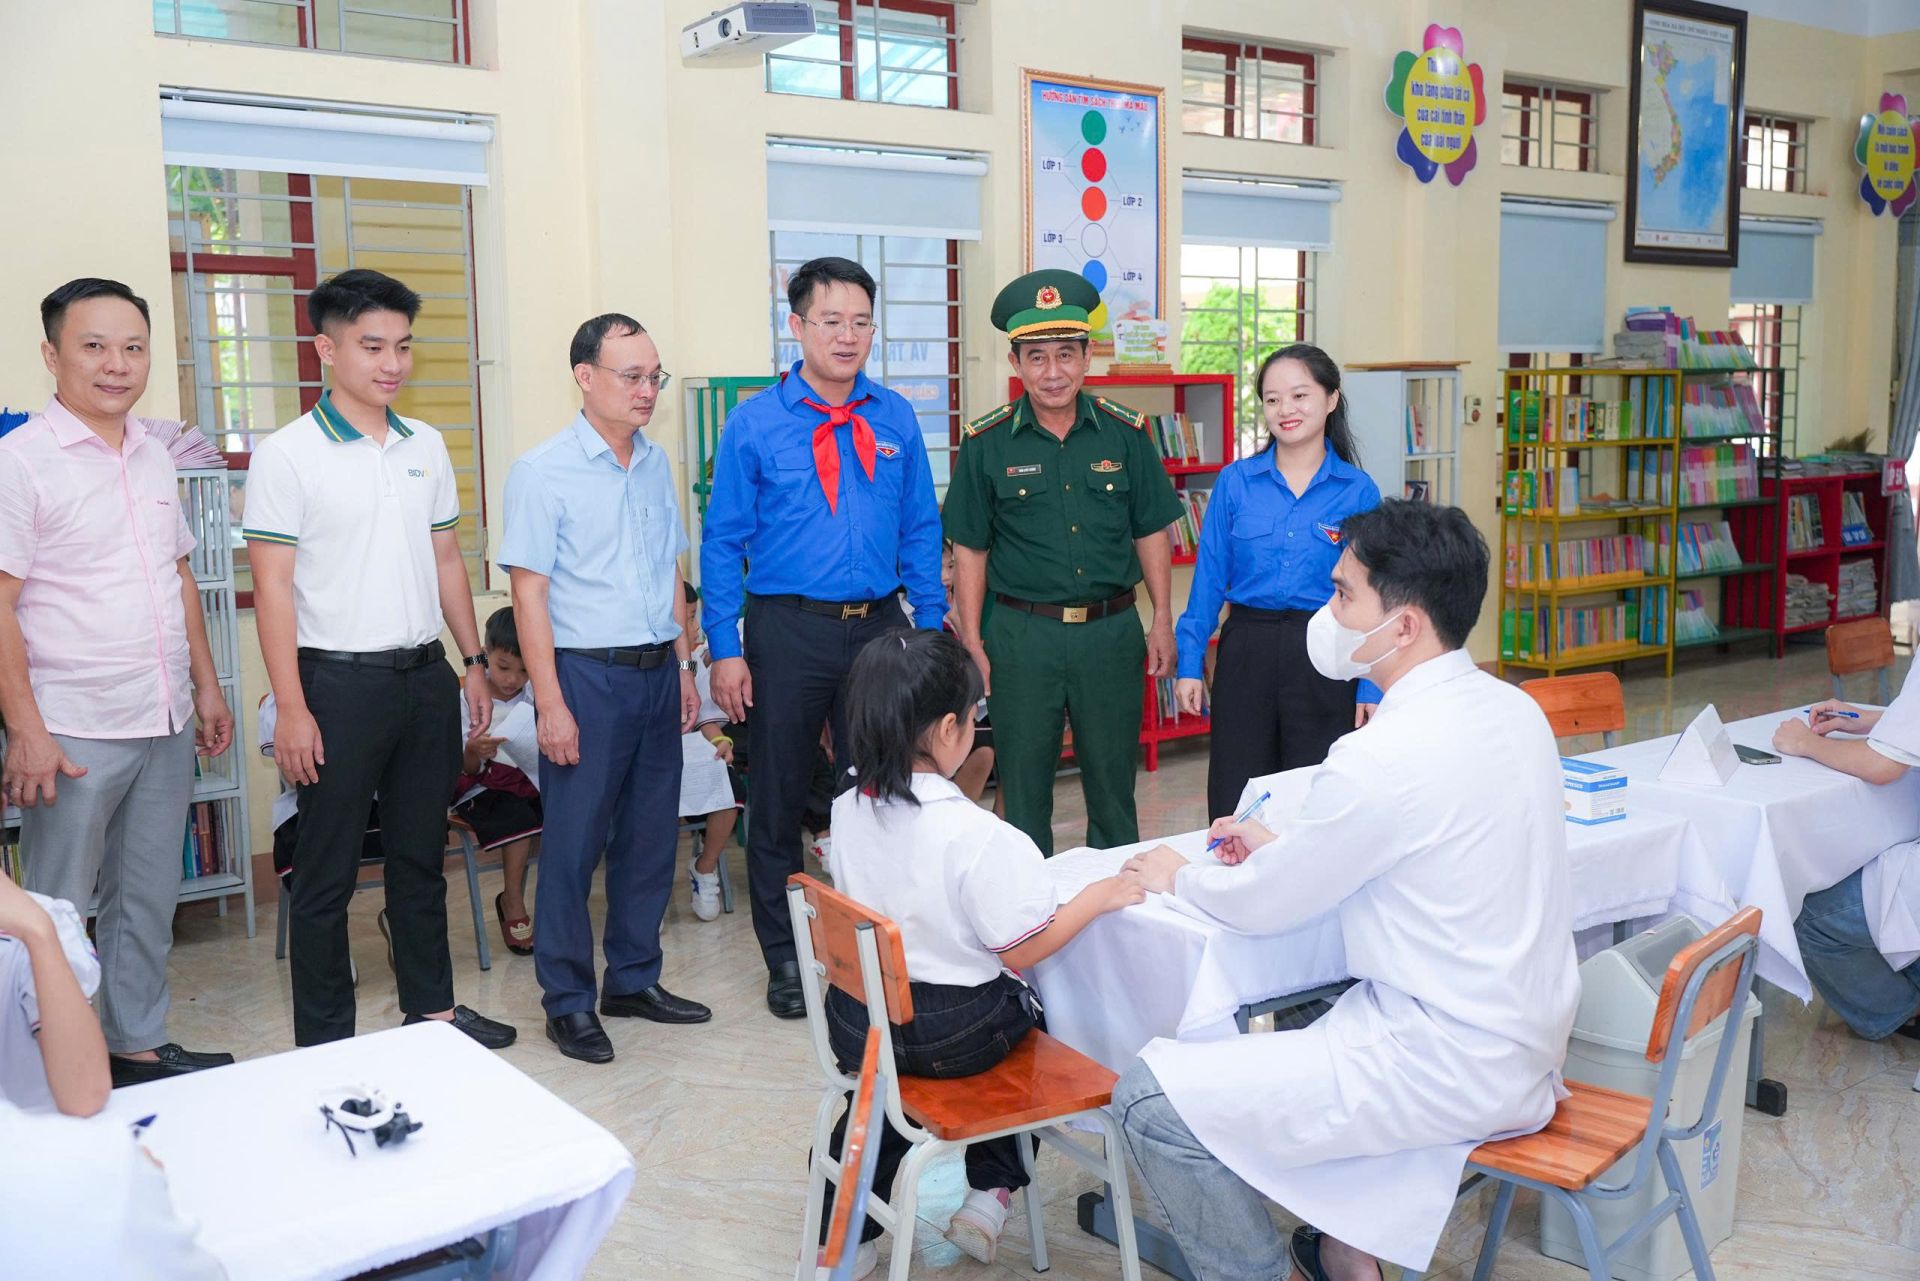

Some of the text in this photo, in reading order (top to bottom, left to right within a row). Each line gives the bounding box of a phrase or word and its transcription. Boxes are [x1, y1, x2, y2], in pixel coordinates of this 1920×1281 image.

[1042, 158, 1056, 170] LỚP
[1122, 195, 1142, 207] LỚP 2
[1043, 231, 1063, 244] LỚP 3
[1123, 270, 1142, 281] LỚP 4
[408, 469, 424, 478] BIDV
